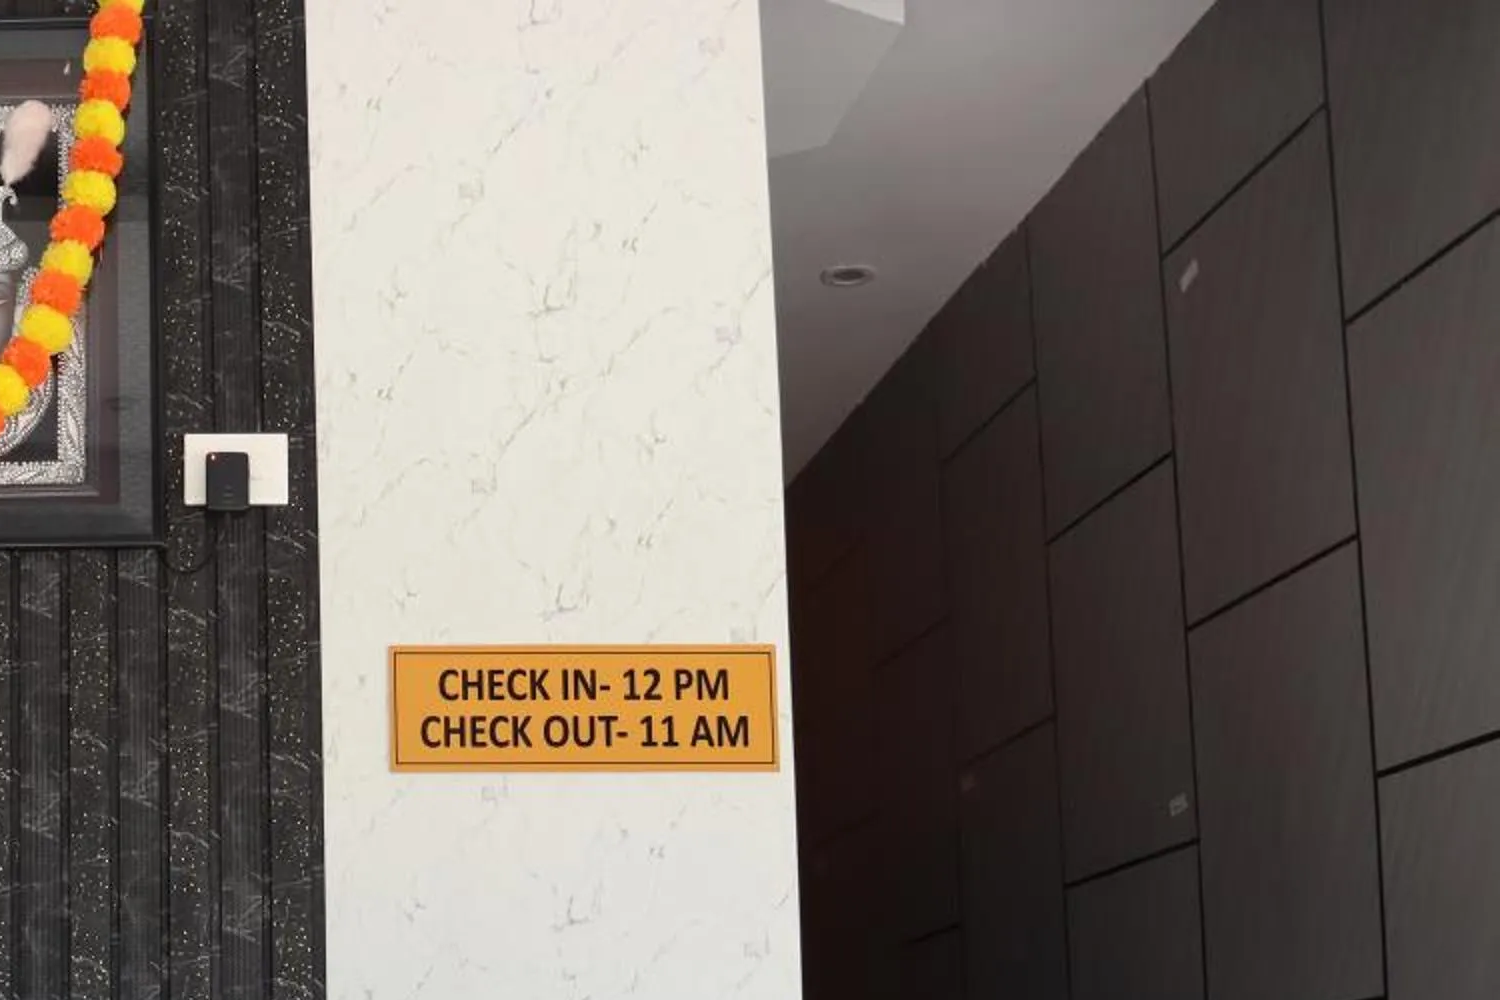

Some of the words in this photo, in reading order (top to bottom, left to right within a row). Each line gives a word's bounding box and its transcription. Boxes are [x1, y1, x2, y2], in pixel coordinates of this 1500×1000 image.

[439, 669, 550, 701] CHECK
[562, 669, 610, 700] IN-
[623, 668, 662, 700] 12
[675, 669, 728, 700] PM
[421, 716, 532, 748] CHECK
[544, 716, 628, 748] OUT-
[641, 716, 679, 747] 11
[691, 716, 748, 747] AM
